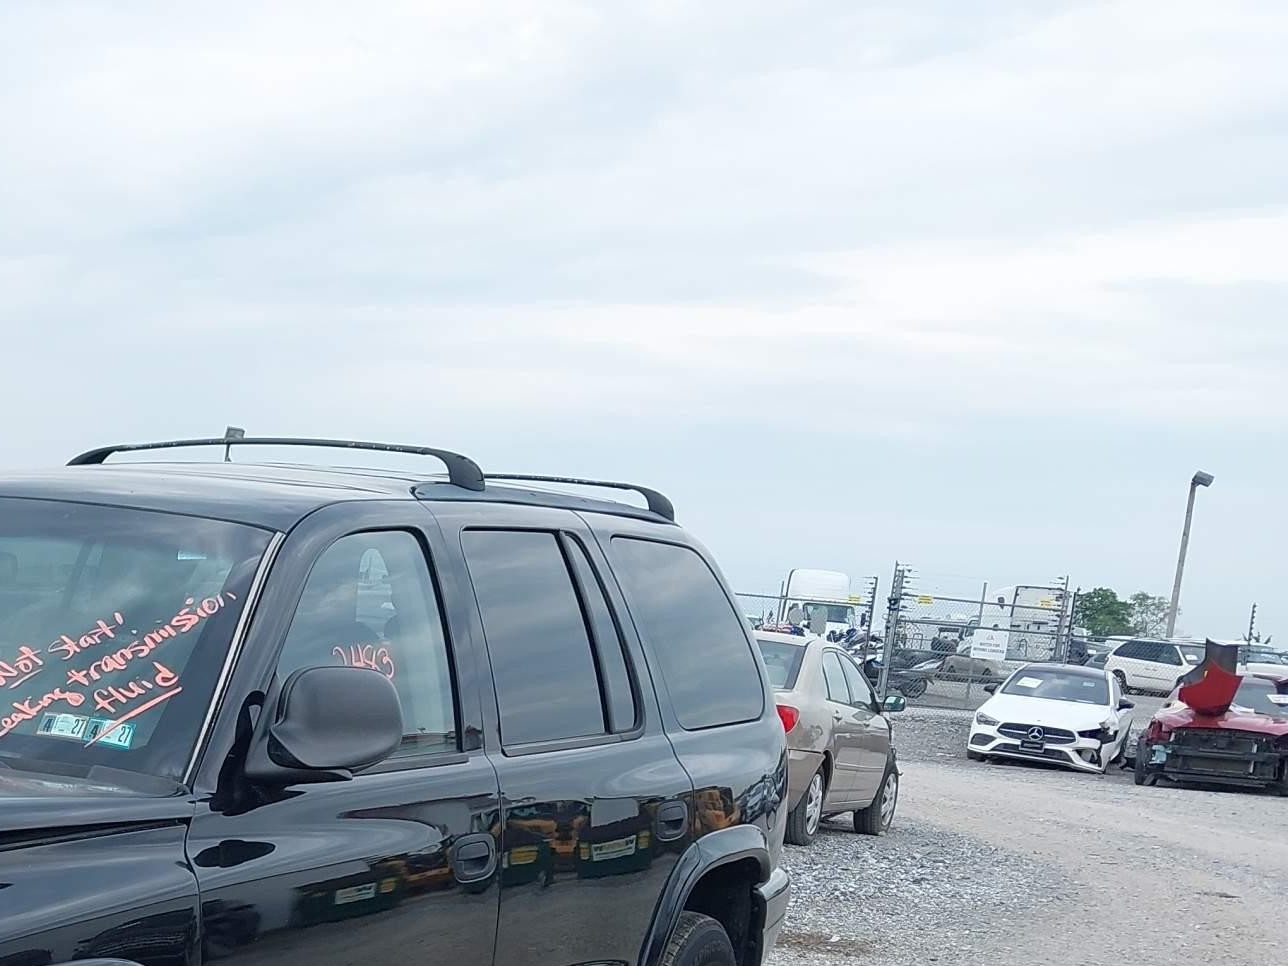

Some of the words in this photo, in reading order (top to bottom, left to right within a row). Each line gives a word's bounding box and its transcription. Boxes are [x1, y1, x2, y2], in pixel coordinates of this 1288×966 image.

[93, 662, 179, 714] fluid
[71, 718, 87, 735] 27
[117, 725, 133, 744] 27
